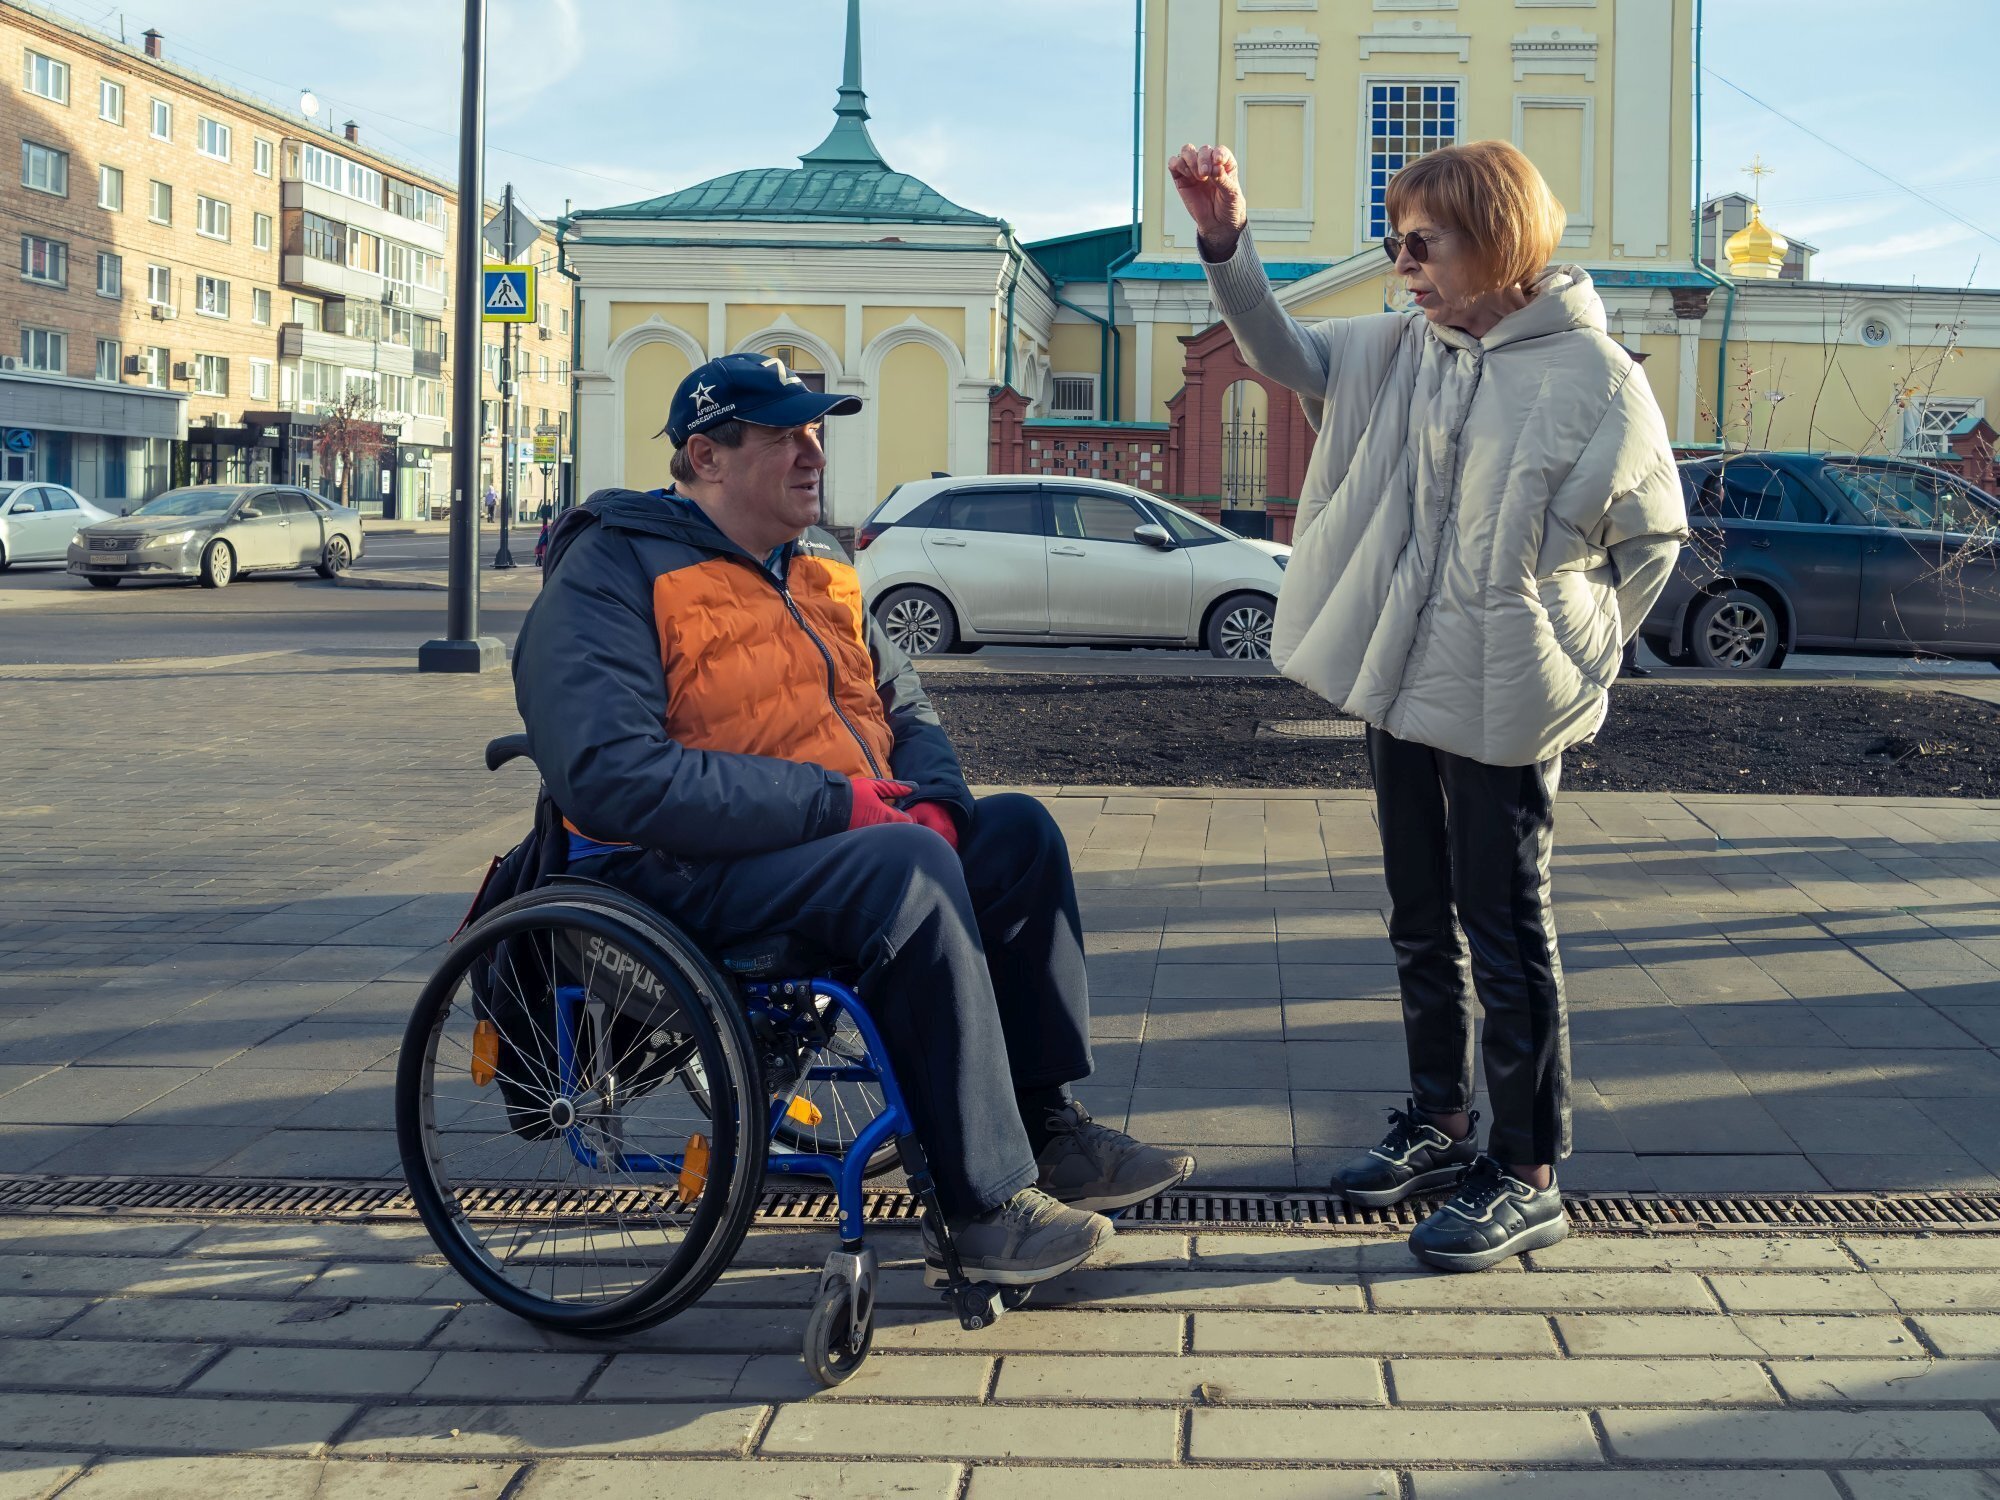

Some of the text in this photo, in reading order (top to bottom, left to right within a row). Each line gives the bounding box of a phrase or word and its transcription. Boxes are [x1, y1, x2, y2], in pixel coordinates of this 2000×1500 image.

[687, 403, 736, 431] ПОБЕДИТЕЛЕЙ
[697, 402, 720, 417] АРМИЯ
[586, 936, 666, 1001] SOPUR
